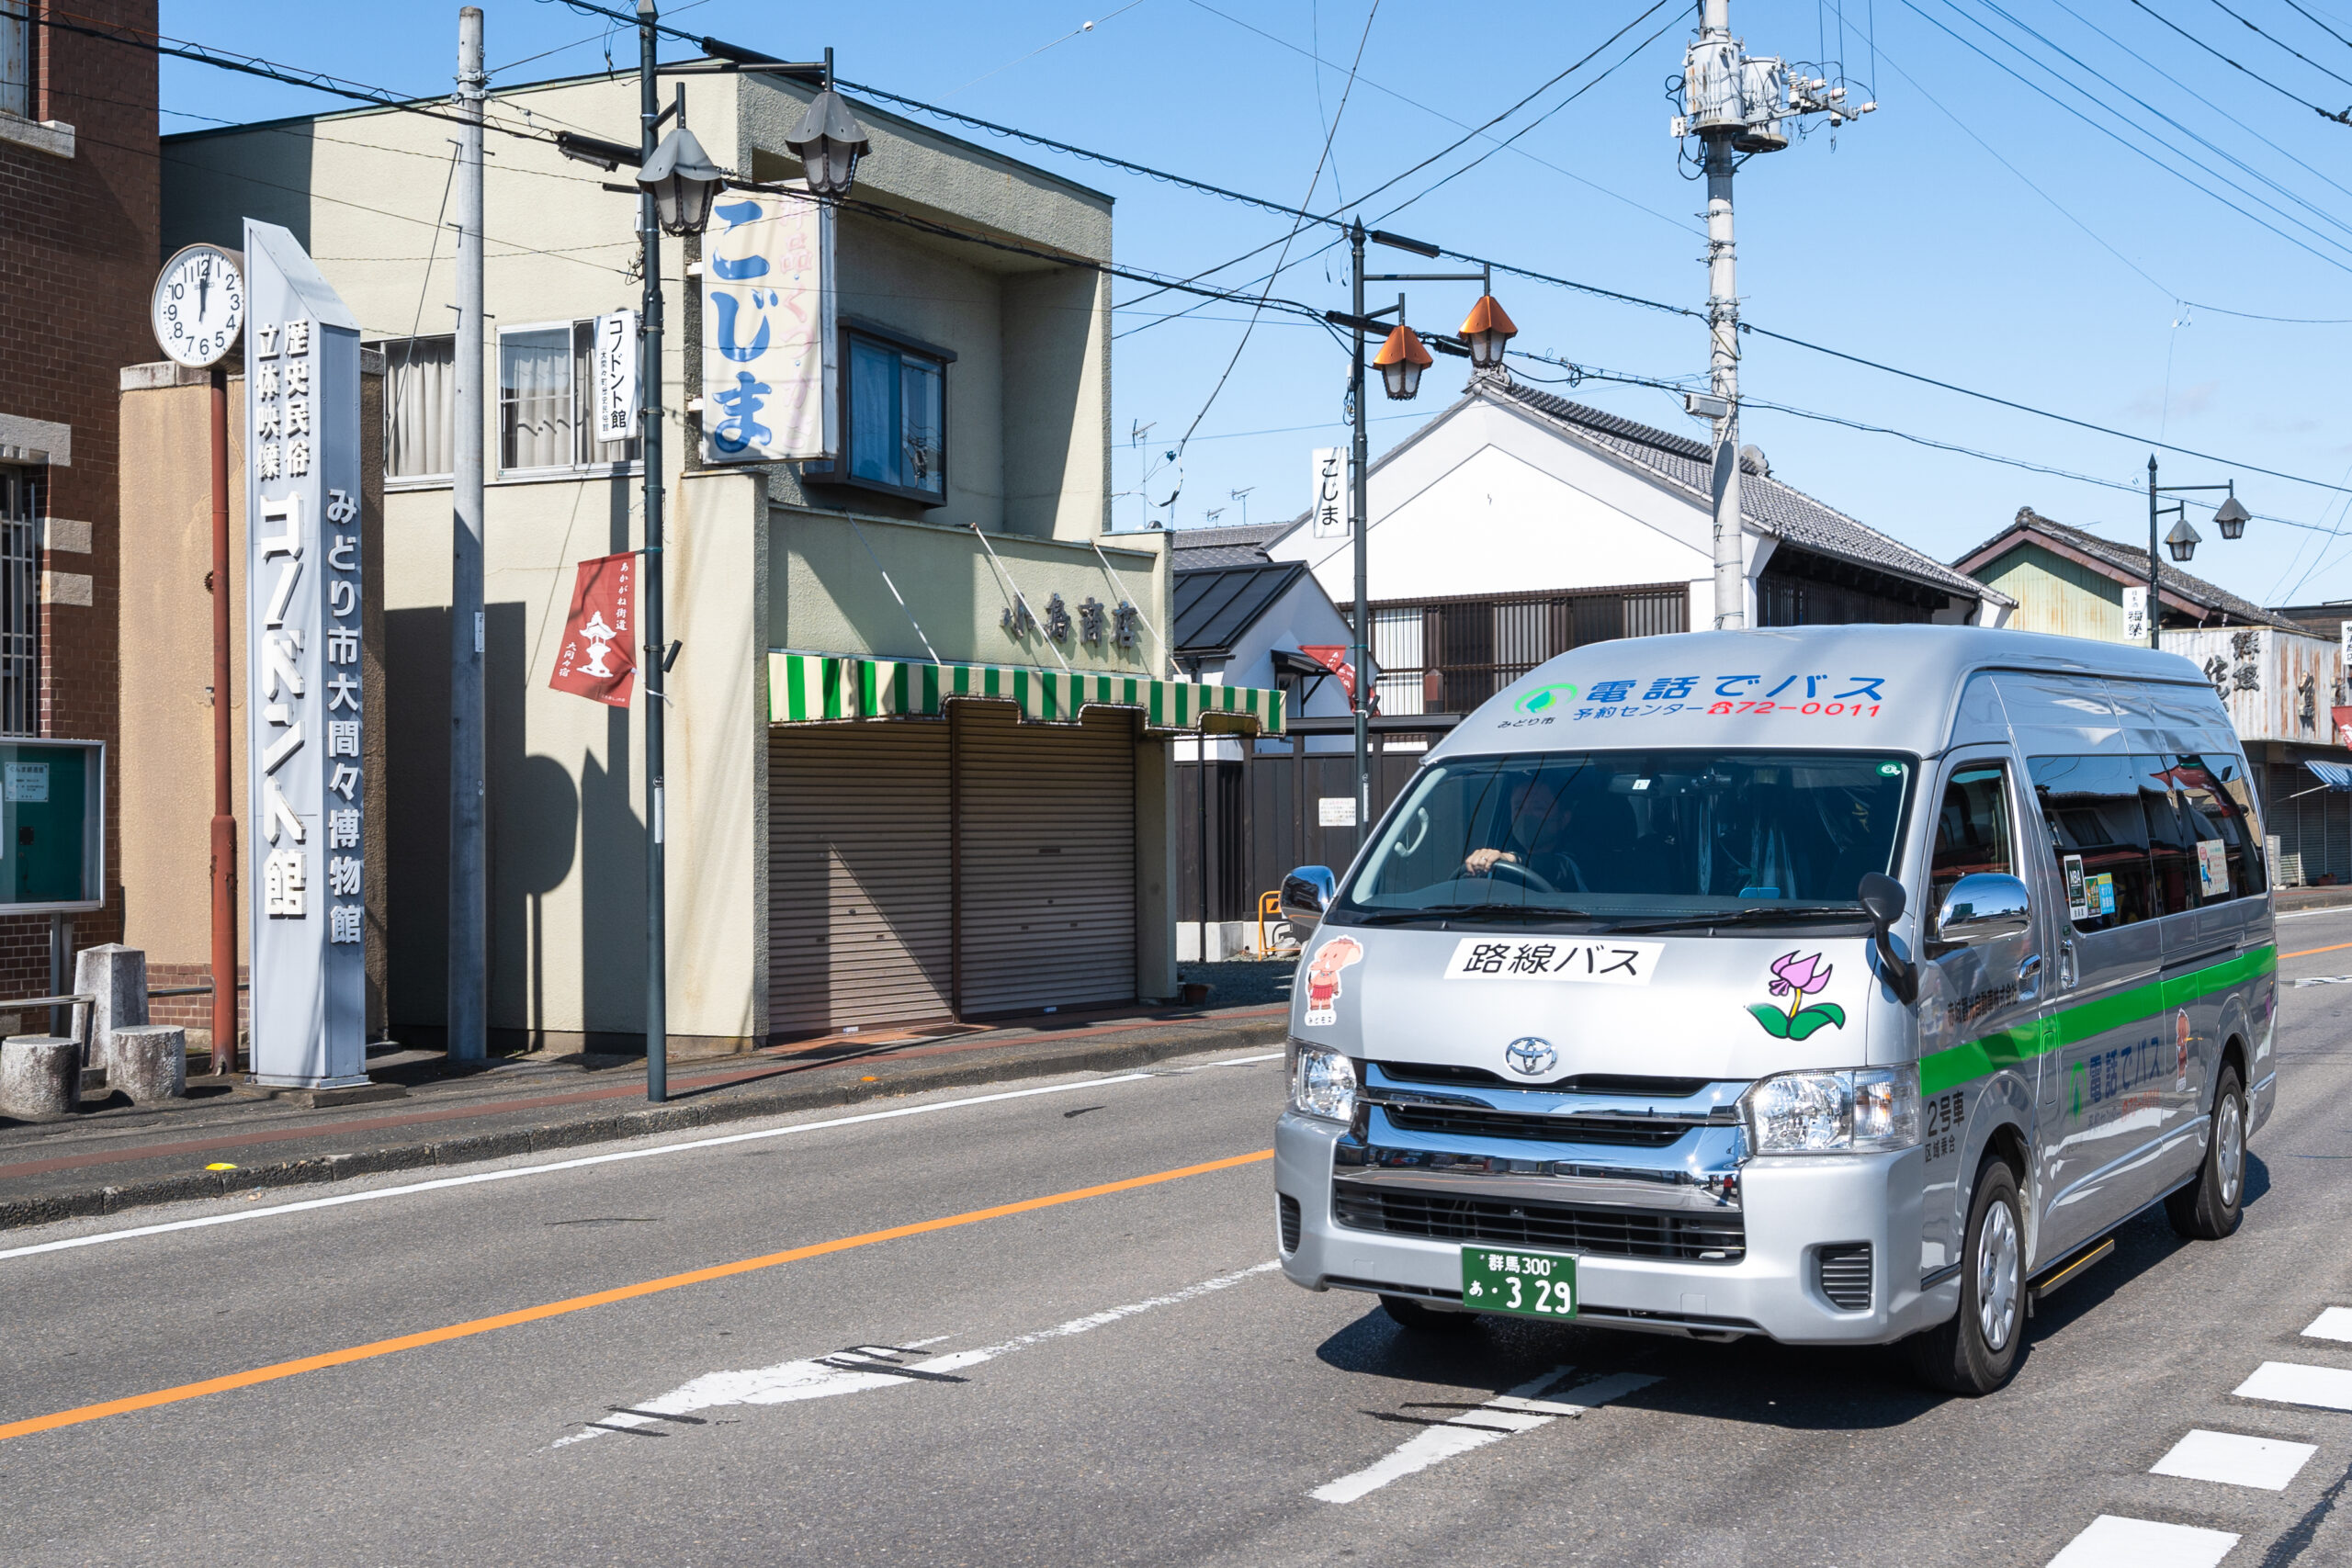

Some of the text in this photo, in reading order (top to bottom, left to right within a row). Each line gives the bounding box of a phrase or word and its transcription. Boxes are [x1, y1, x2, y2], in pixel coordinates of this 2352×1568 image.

[171, 282, 185, 301] 10
[225, 273, 235, 291] 2
[167, 304, 177, 321] 9
[230, 293, 241, 310] 3
[174, 321, 184, 339] 8
[225, 313, 236, 331] 4
[710, 200, 779, 453] こじま
[186, 335, 196, 353] 7
[199, 338, 209, 355] 6
[215, 331, 225, 348] 5
[609, 319, 627, 429] コノドント館
[255, 323, 280, 480] 立体映像
[284, 318, 310, 478] 歴史民俗
[1321, 457, 1339, 526] こじま
[615, 561, 629, 632] あかがね街道
[1585, 674, 1888, 704] 電話でバス
[260, 491, 306, 917] コノドント館
[1572, 703, 1704, 722] 予約センター
[327, 489, 361, 944] みどり市大間々博物館
[1497, 716, 1556, 728] みどり市
[1463, 942, 1640, 976] 路線バス
[2089, 1036, 2160, 1103] 電話でバス
[1927, 1090, 1964, 1137] 2号車
[1468, 1280, 1484, 1297] あ
